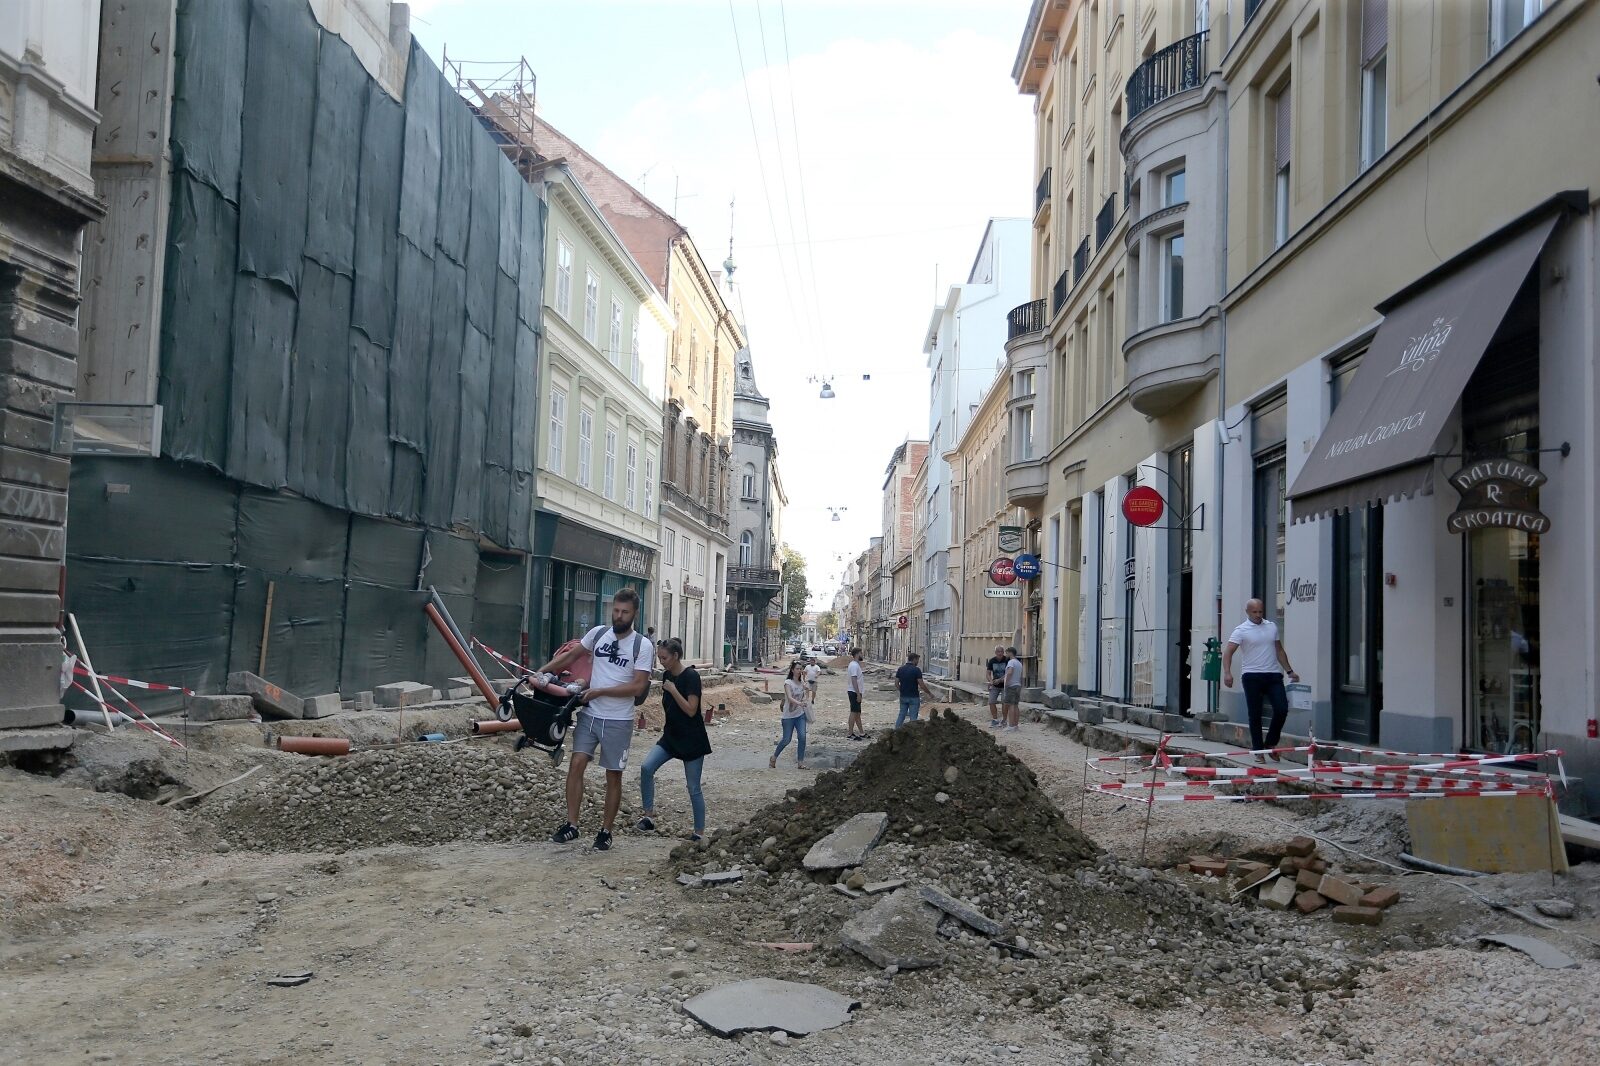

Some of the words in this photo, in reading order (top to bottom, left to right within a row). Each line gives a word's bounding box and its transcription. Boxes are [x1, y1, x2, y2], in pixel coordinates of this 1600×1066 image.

[1324, 432, 1369, 460] NATURA
[1368, 410, 1427, 445] CROATICA
[1457, 462, 1539, 489] NATURA
[1453, 511, 1545, 532] CROATICA
[600, 642, 619, 655] JUS
